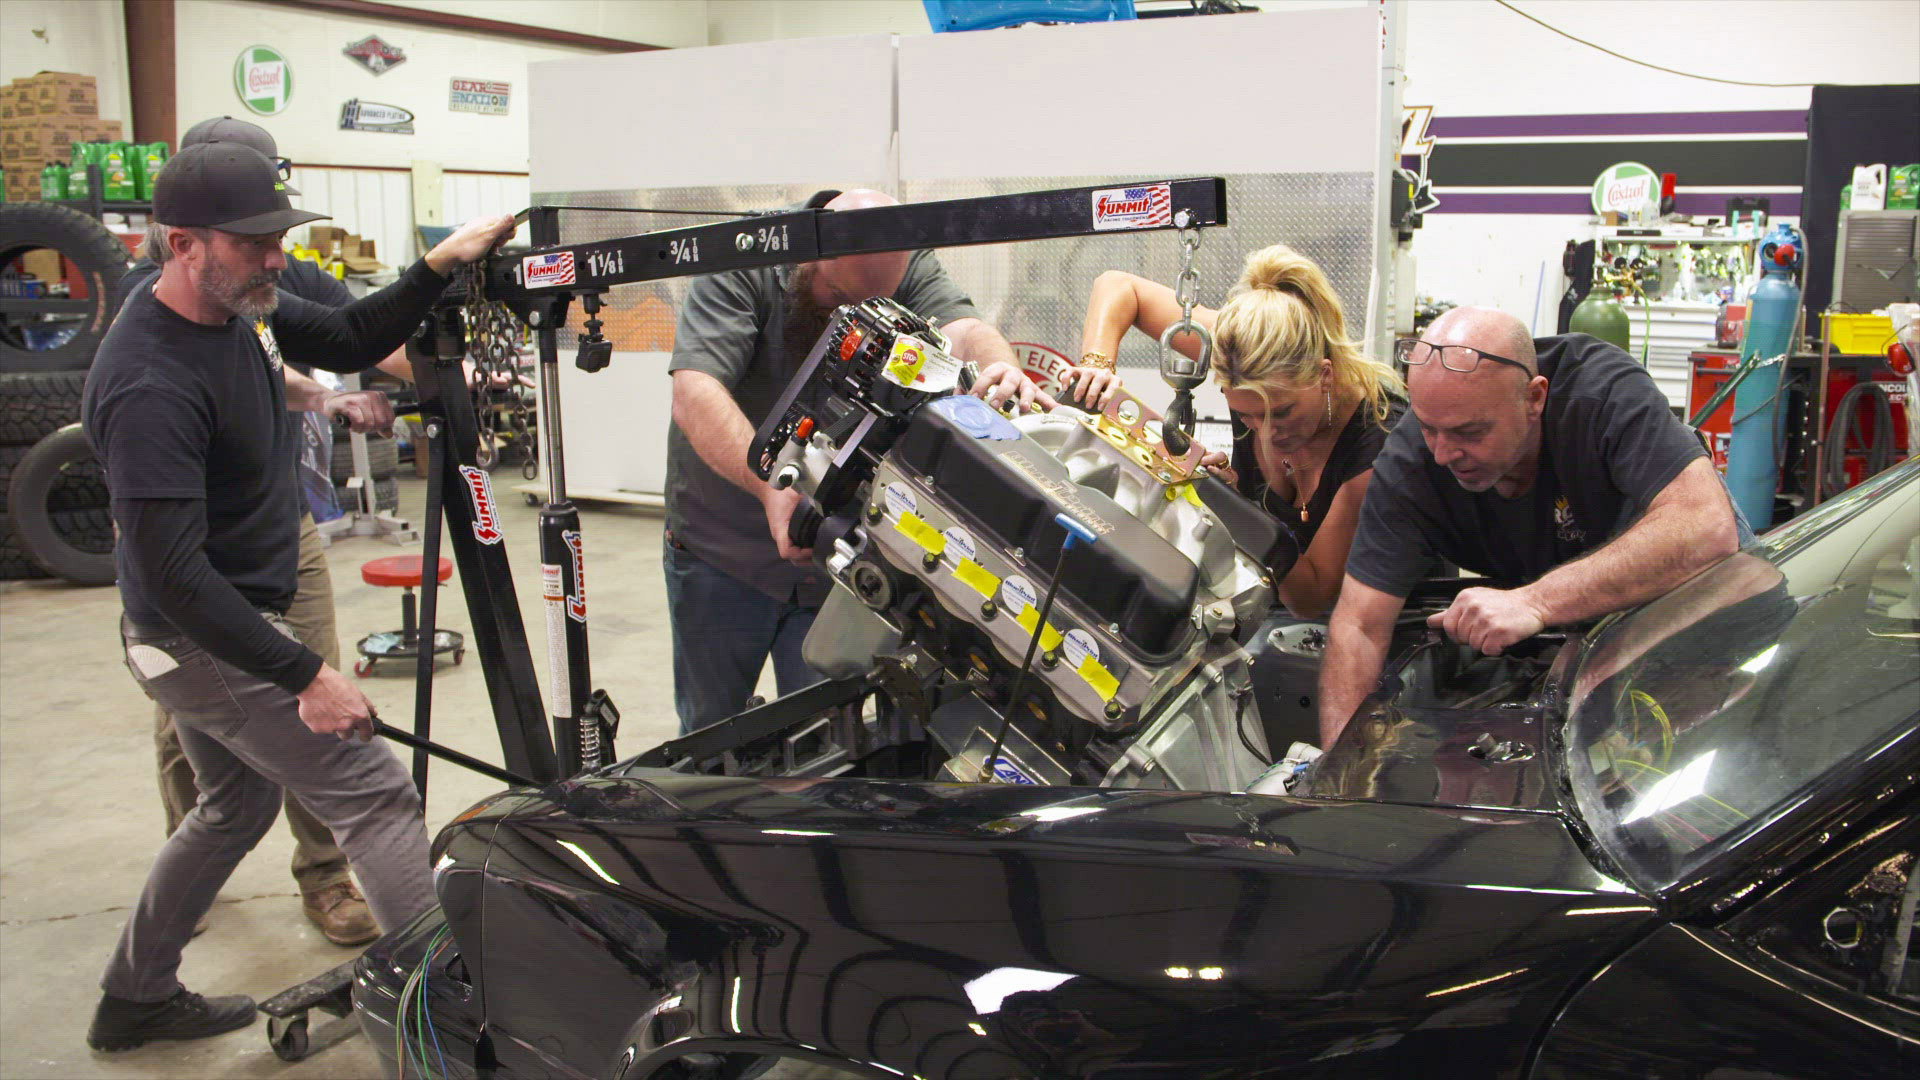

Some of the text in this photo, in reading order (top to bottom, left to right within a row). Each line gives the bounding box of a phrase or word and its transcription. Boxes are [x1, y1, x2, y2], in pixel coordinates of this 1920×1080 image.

[248, 64, 282, 93] Castrol
[452, 80, 486, 93] GEAR
[460, 93, 508, 107] NATION
[1607, 180, 1647, 207] Castrol
[1098, 197, 1149, 218] SUMMIT
[758, 226, 780, 252] 3/8
[670, 239, 691, 264] 3/4
[528, 262, 561, 279] SUMMIT
[902, 352, 918, 363] STOP
[468, 472, 498, 540] SUMMIT
